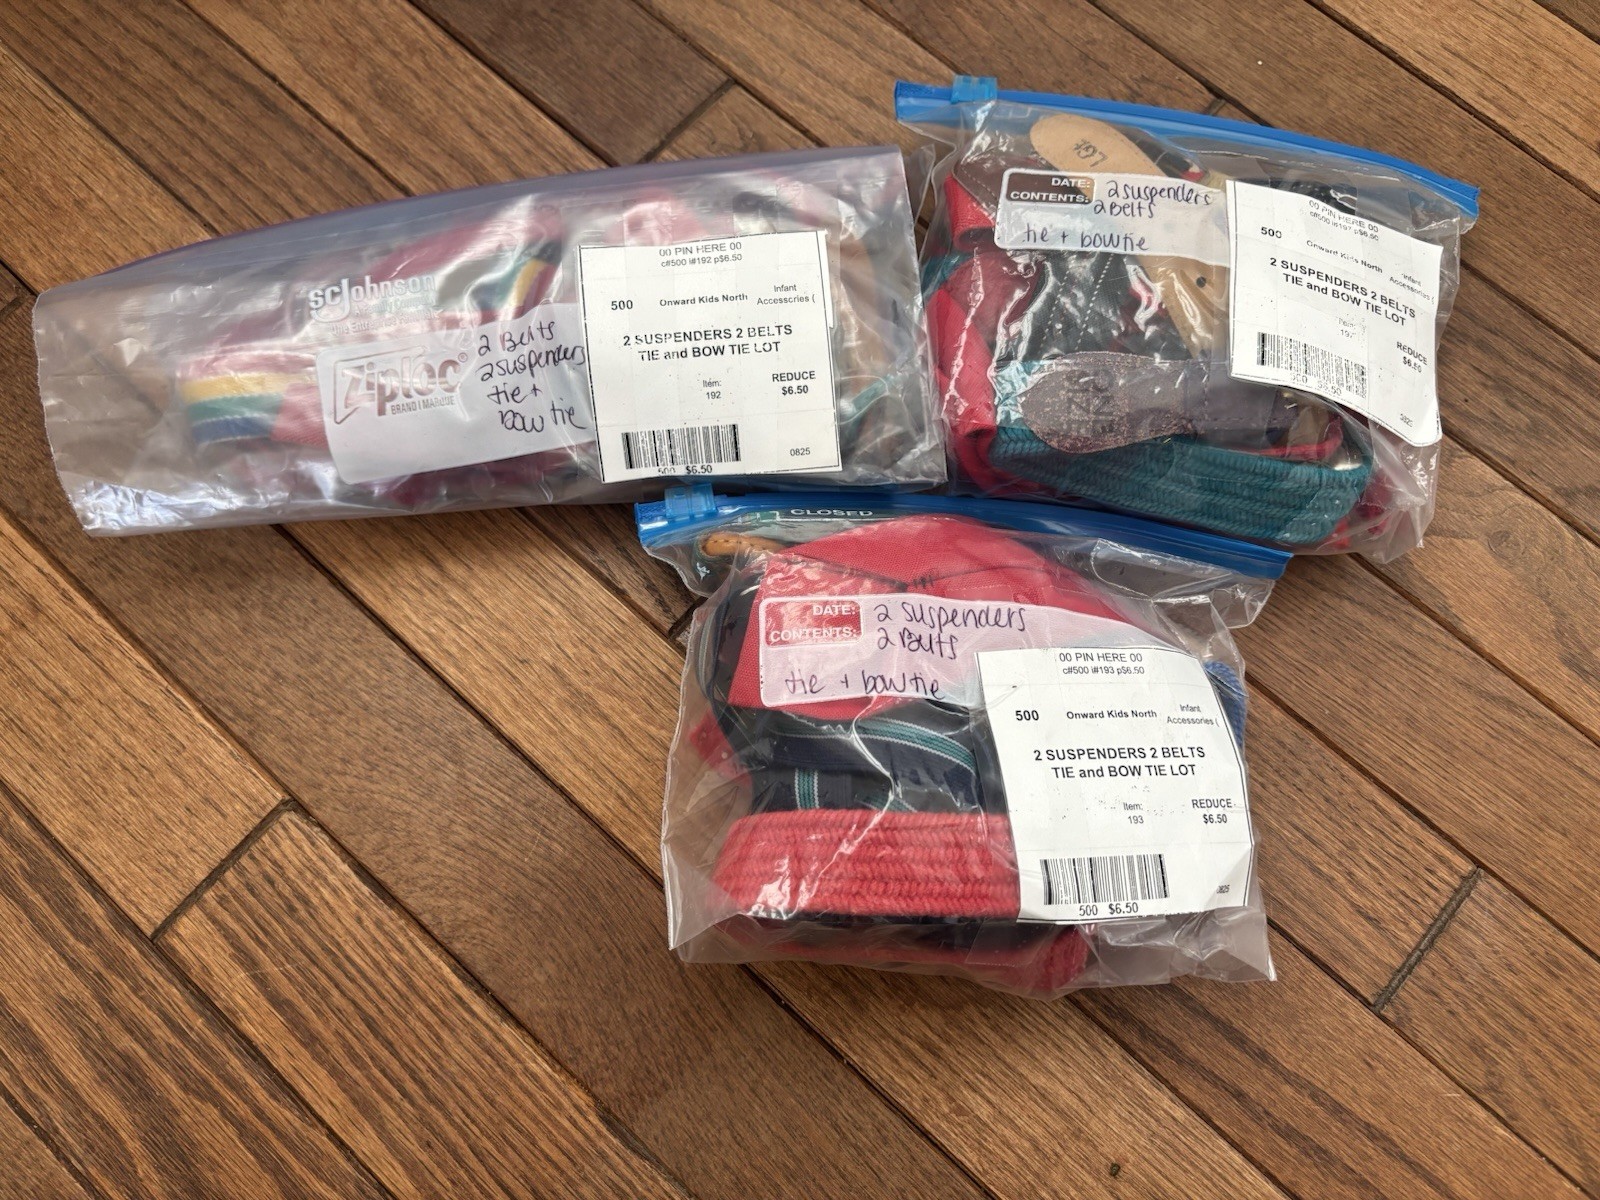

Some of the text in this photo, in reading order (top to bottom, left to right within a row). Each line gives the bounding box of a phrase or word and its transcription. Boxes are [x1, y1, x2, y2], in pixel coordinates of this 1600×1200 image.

[1051, 178, 1091, 188] DATE:
[1010, 190, 1089, 203] CONTENTS:
[1338, 214, 1366, 229] HERE
[1024, 222, 1048, 244] tie
[1060, 233, 1069, 244] +
[1260, 226, 1283, 240] 500
[659, 241, 742, 257] 00 PIN HERE 00
[1360, 259, 1383, 274] North
[773, 284, 797, 293] Infant
[1270, 257, 1417, 319] 2 SUSPENDERS 2 BELTS
[610, 292, 748, 311] 500 Onward Kids North
[1282, 272, 1407, 327] TIE and BOW TIE LOT
[622, 324, 793, 347] 2 SUSPENDERS 2 BELTS
[638, 341, 782, 362] TIE and BOW TIE LOT
[1396, 341, 1428, 366] REDUCE
[702, 378, 722, 388] Item:
[771, 370, 817, 383] REDUCE
[705, 390, 722, 401] 192
[780, 384, 809, 396] $6.50
[390, 400, 418, 416] BRAND
[790, 447, 811, 457] 0825
[685, 464, 713, 475] $6.50
[790, 508, 874, 518] CLOSED
[812, 604, 857, 616] DATE:
[873, 600, 1027, 632] 2 suspenders
[770, 627, 858, 643] CONTENTS:
[878, 628, 896, 650] 2
[1059, 652, 1143, 663] 00 PIN HERE 00
[1062, 666, 1145, 677] c#500 i#193 p$6.50
[784, 669, 826, 695] tie
[1179, 703, 1201, 713] Infant
[1015, 709, 1158, 722] 500 Onward Kids North
[1166, 716, 1215, 726] Accessories
[1034, 746, 1206, 762] 2 SUSPENDERS 2 BELTS
[1051, 764, 1197, 779] TIE and BOW TIE LOT
[1123, 802, 1144, 811] Item:
[1192, 798, 1233, 809] REDUCE
[1128, 815, 1145, 825] 193
[1202, 814, 1228, 825] $6.50
[1078, 904, 1099, 917] 500
[1108, 902, 1140, 916] $6.50
